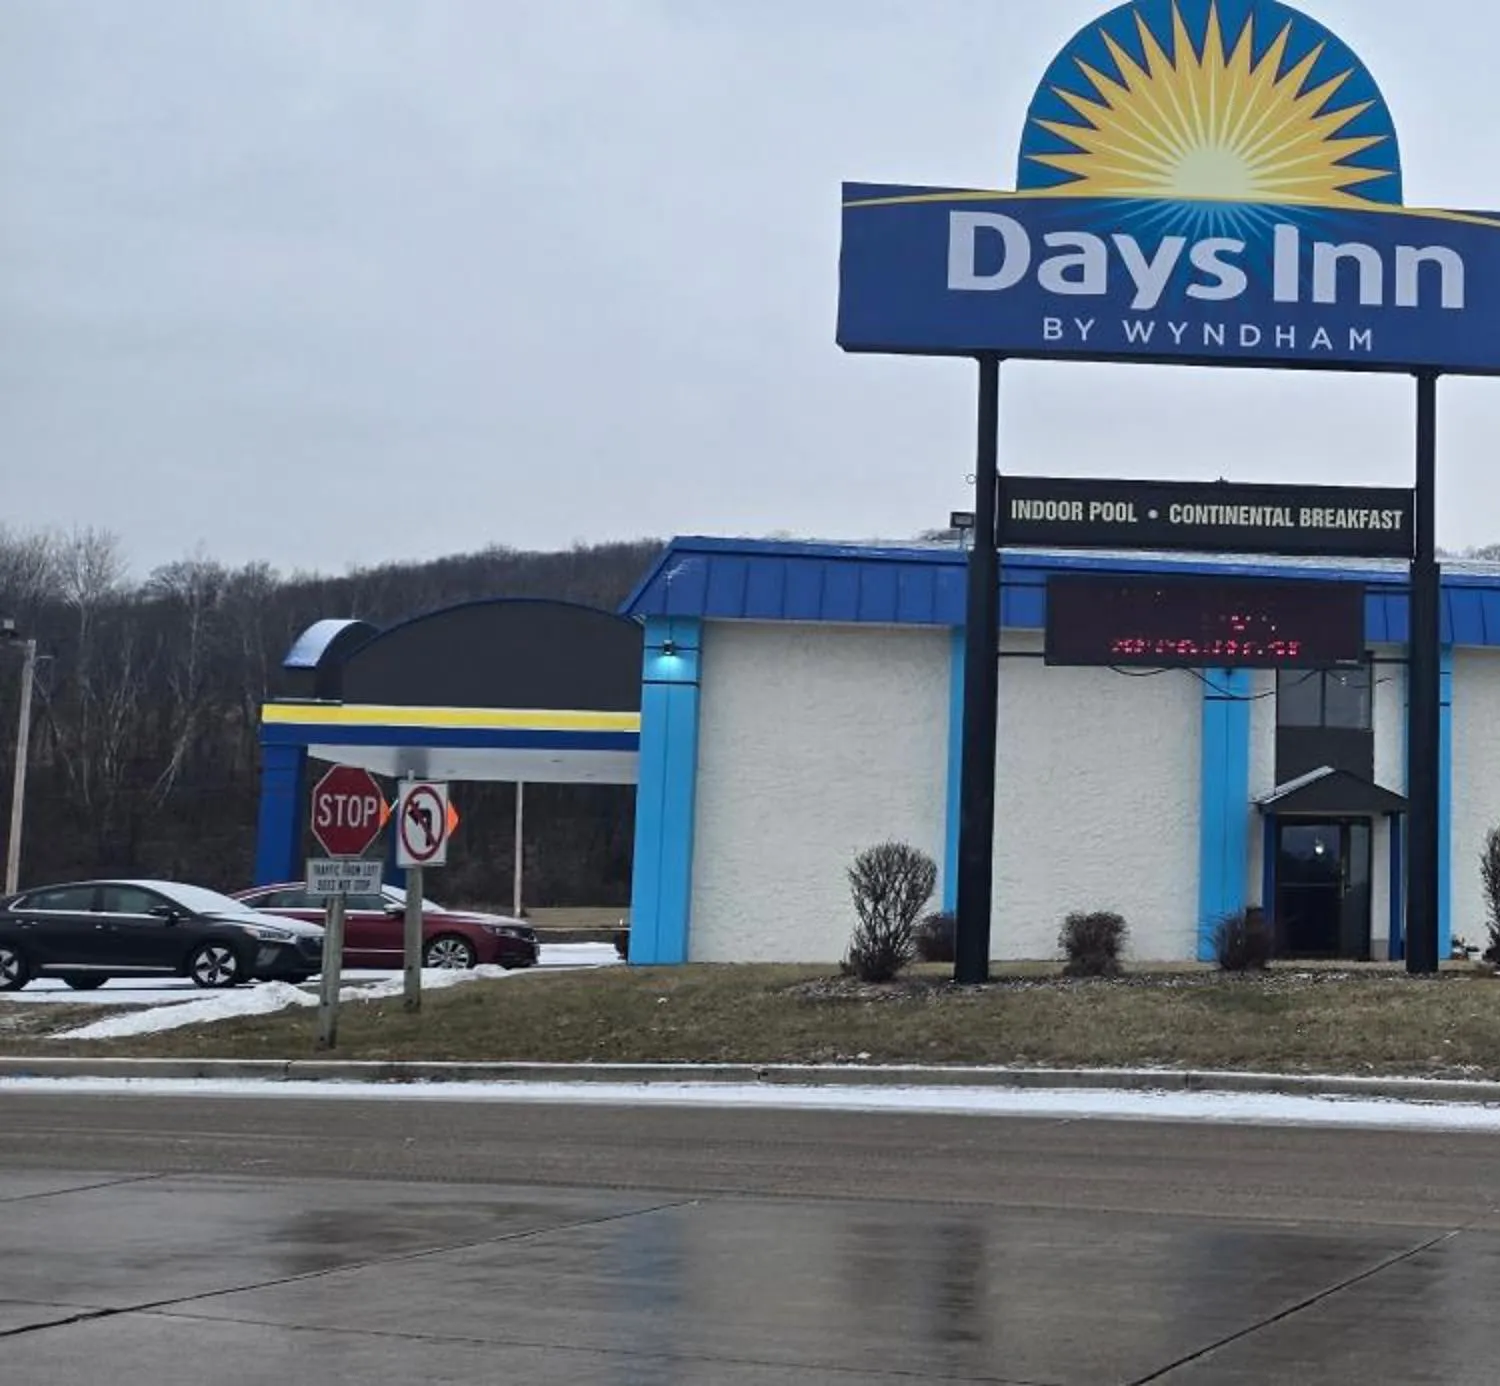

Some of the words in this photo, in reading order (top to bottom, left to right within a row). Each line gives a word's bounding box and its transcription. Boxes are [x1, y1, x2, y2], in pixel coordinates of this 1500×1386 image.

[947, 210, 1247, 310] Days
[1273, 223, 1464, 309] Inn
[1043, 317, 1095, 341] BY
[1122, 320, 1373, 351] WYNDHAM
[1011, 499, 1083, 521] INDOOR
[1089, 501, 1138, 523] POOL
[1169, 503, 1295, 527] CONTINENTAL
[1299, 507, 1403, 530] BREAKFAST
[317, 793, 377, 828] STOP
